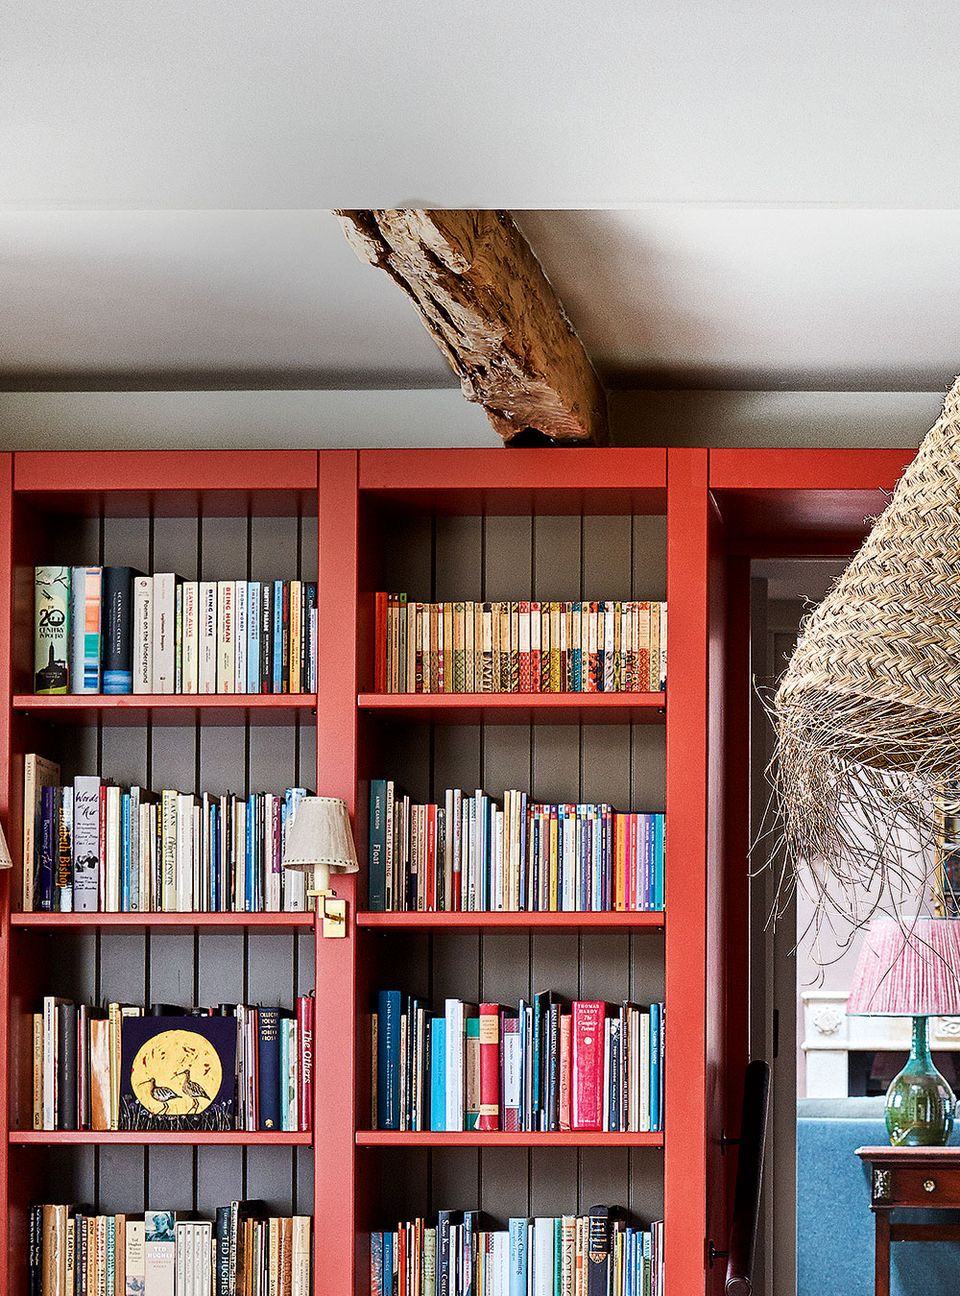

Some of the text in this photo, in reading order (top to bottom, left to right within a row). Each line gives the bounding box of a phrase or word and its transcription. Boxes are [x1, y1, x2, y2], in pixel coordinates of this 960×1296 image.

[56, 856, 70, 889] Bishop
[303, 1029, 312, 1084] The Others
[221, 1236, 230, 1295] TED HUGHES
